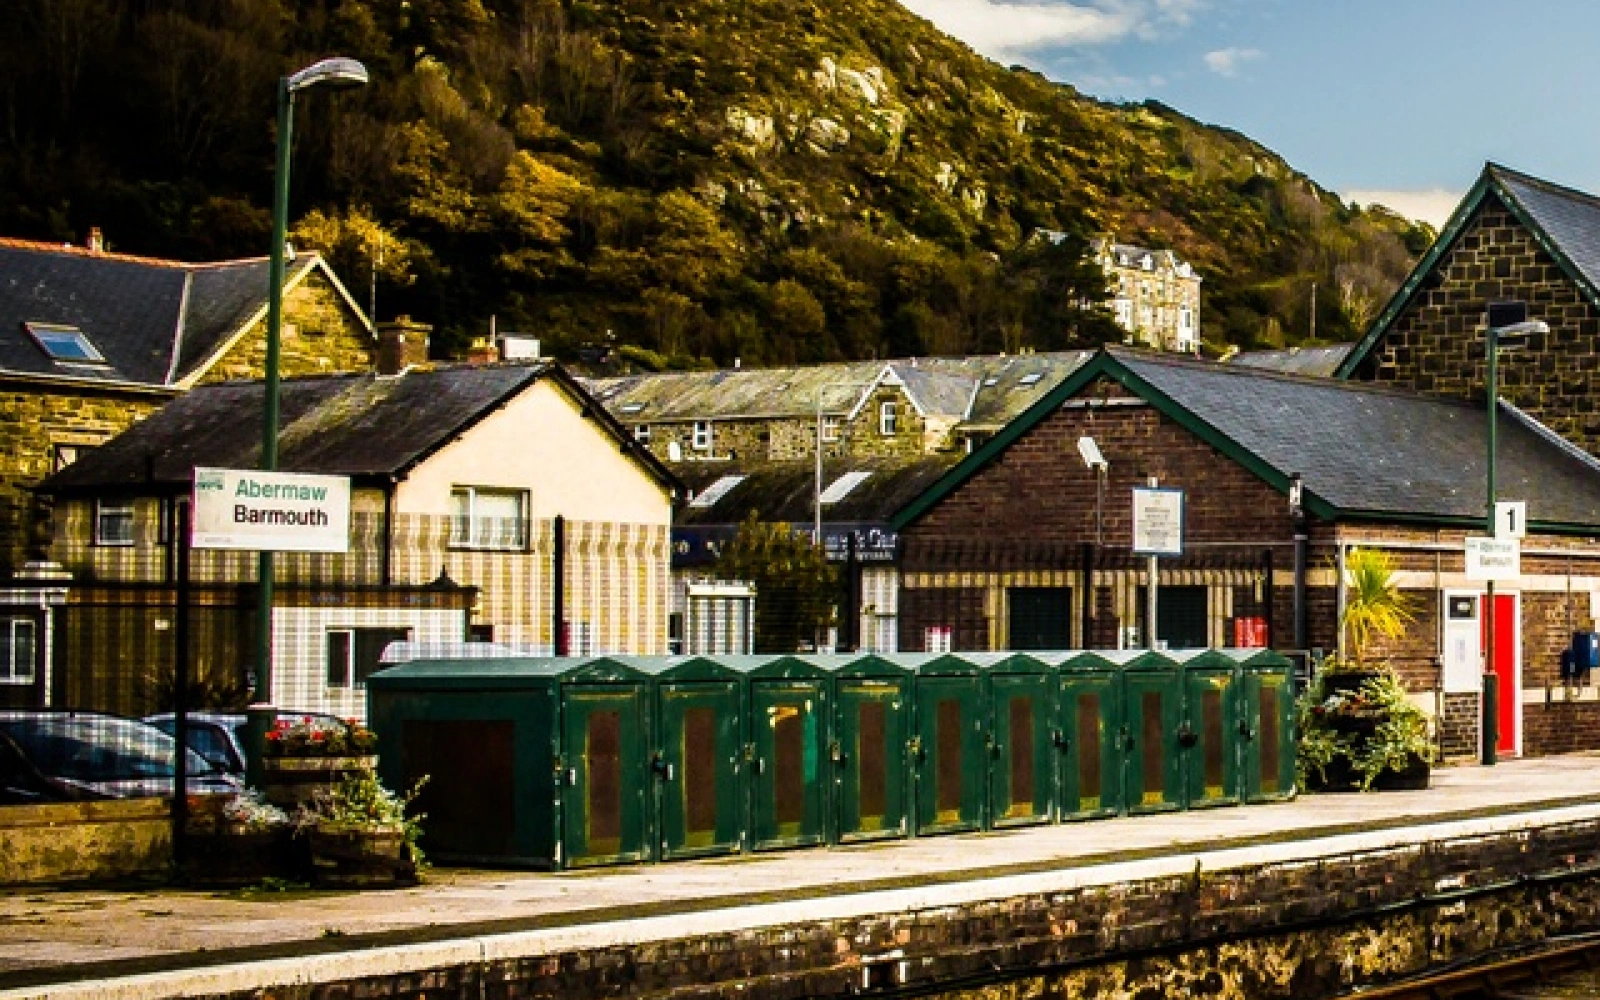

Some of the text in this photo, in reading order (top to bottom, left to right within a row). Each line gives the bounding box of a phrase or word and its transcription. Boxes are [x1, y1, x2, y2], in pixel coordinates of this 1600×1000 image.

[235, 479, 328, 501] Abermaw
[234, 504, 329, 526] Barmouth
[1507, 506, 1516, 532] 1
